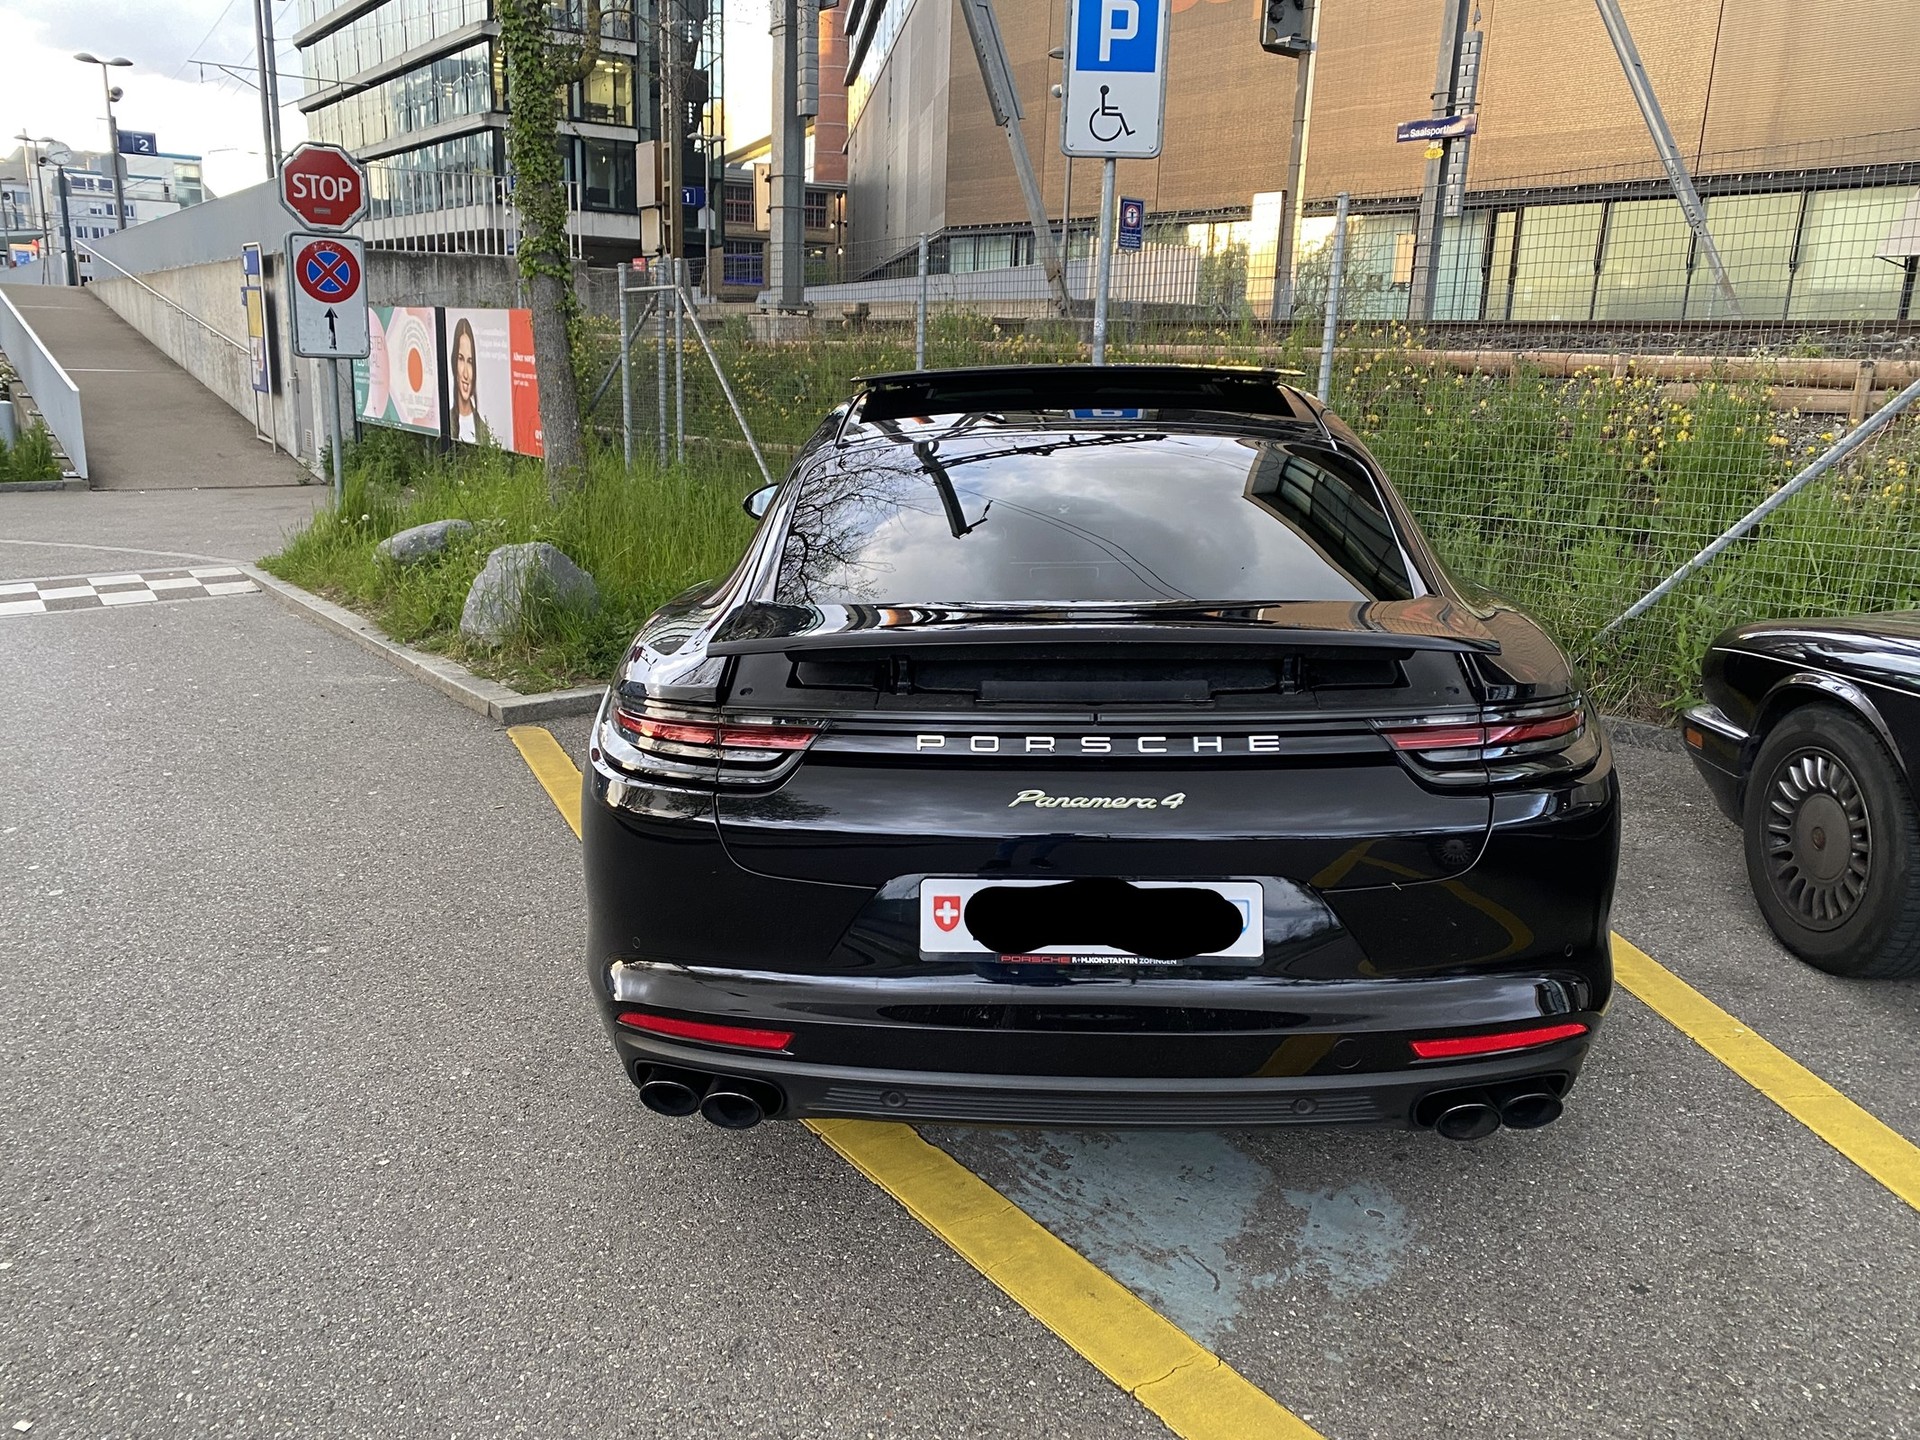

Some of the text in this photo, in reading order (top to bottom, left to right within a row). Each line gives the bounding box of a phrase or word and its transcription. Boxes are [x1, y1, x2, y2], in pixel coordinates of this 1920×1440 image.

[1099, 0, 1139, 61] P
[139, 139, 149, 151] 2
[292, 173, 352, 202] STOP
[685, 192, 690, 202] 1
[916, 735, 1280, 753] PORSCHE
[1008, 789, 1186, 809] Panamera 4
[1000, 955, 1071, 963] PORSCHE
